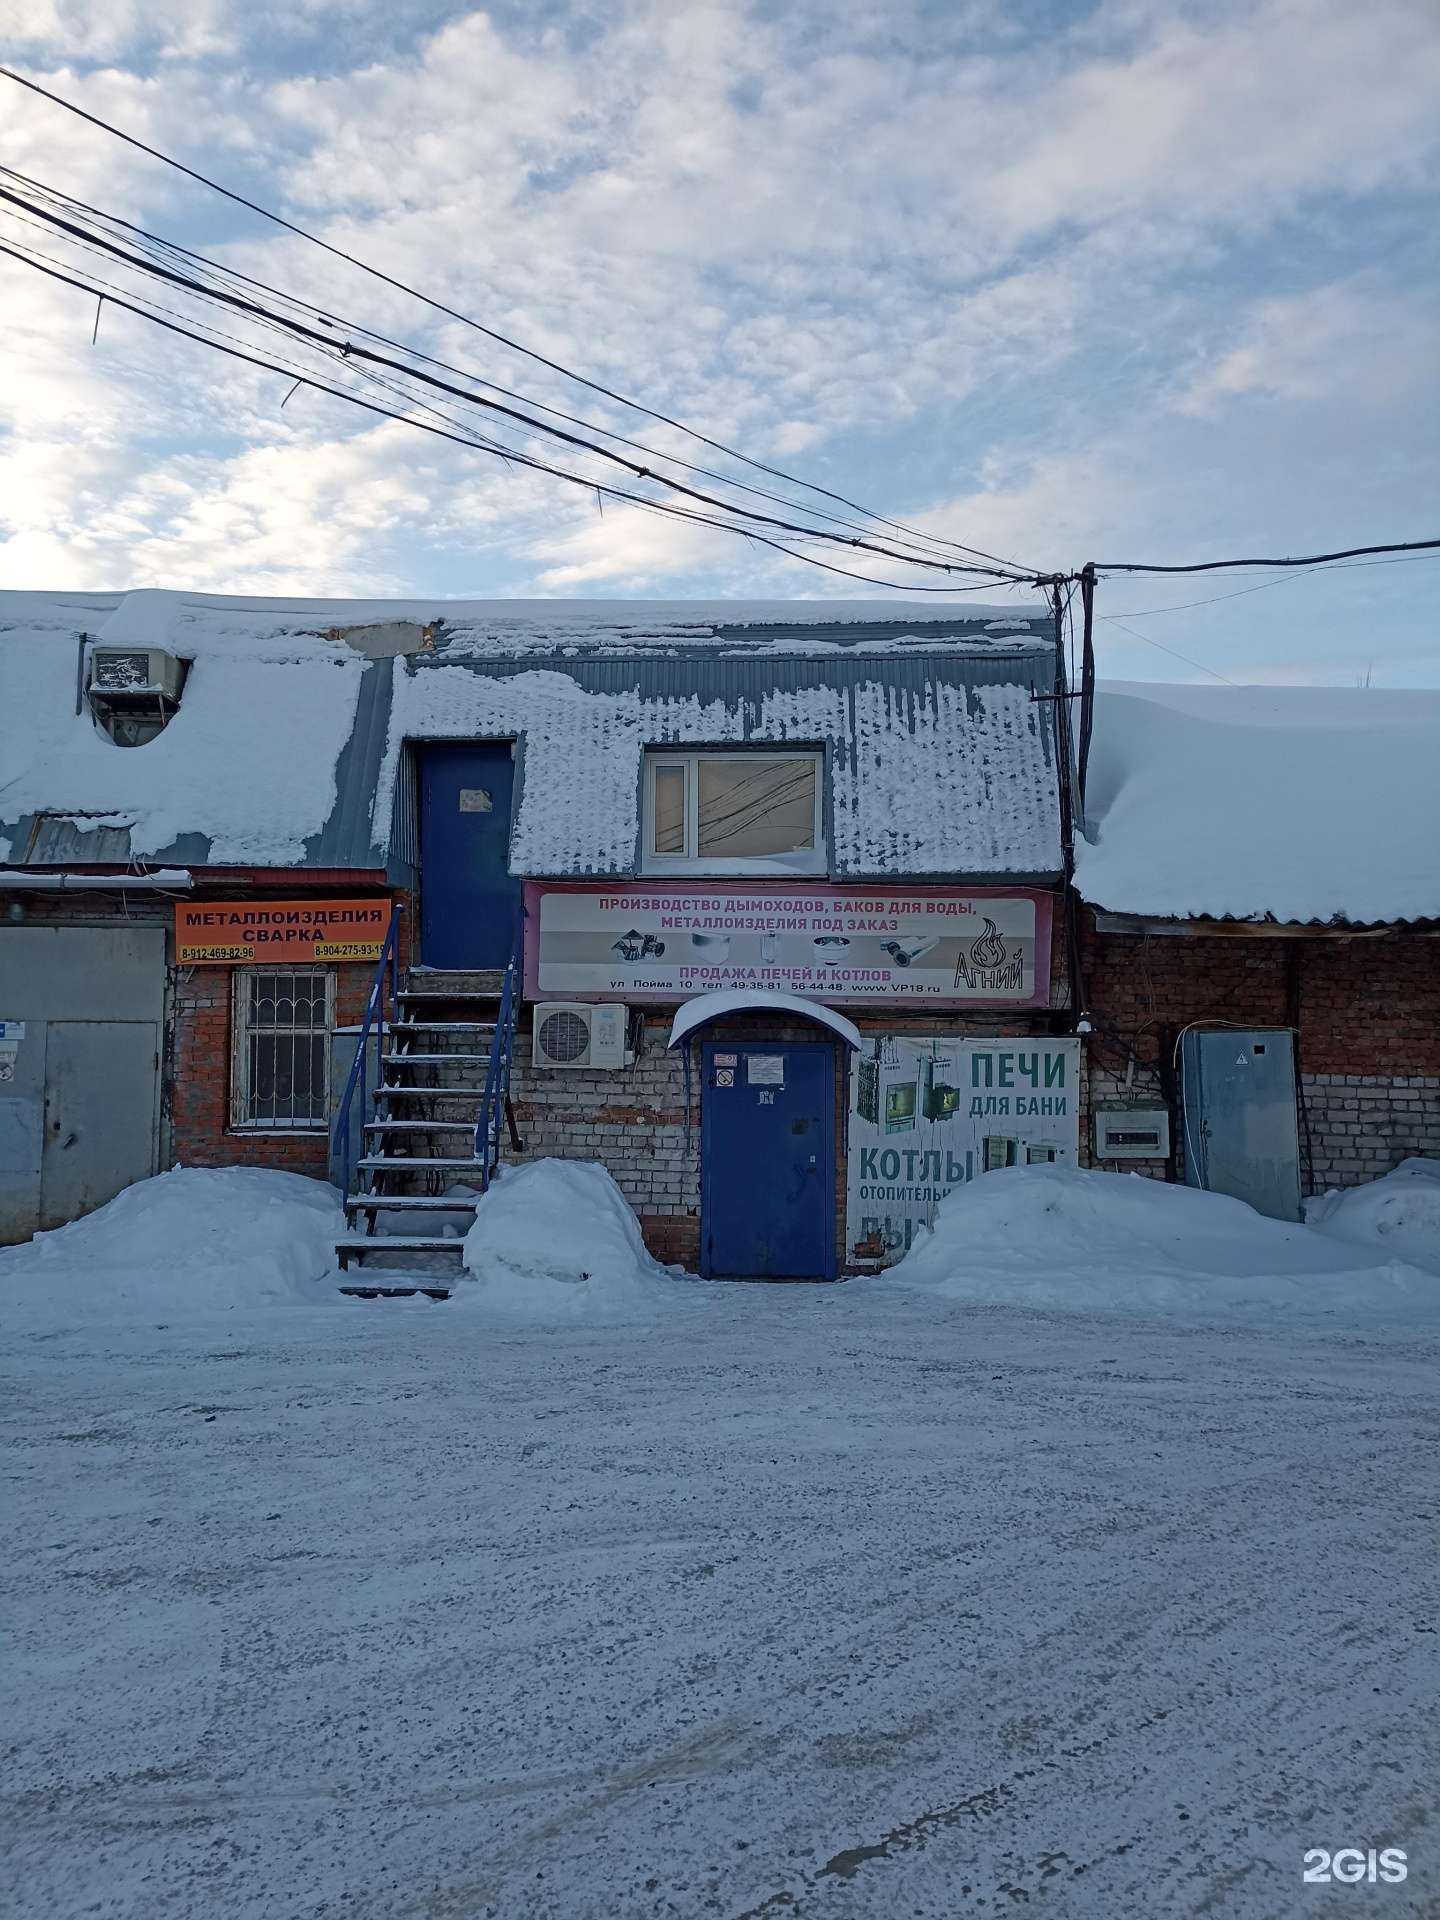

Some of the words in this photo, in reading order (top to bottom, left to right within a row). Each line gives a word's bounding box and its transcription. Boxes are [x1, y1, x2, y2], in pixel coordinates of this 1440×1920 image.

[599, 898, 721, 912] ПРОИЗВОДСТВО
[725, 899, 829, 914] ДЫМОХОДОВ,
[833, 901, 885, 914] БАКОВ
[888, 902, 922, 915] ДЛЯ
[926, 902, 977, 916] ВОДЫ,
[186, 909, 383, 926] МЕТАЛЛОИЗДЕЛИЯ
[661, 916, 807, 930] МЕТАЛЛОИЗДЕЛИЯ
[812, 918, 844, 931] ПОД
[847, 919, 898, 931] ЗАКАЗ
[242, 928, 325, 942] СВАРКА
[182, 947, 254, 959] 8-912-469-82-96
[679, 967, 757, 981] ПРОДАЖА
[761, 966, 812, 980] ПЕЧЕЙ
[817, 969, 827, 981] И
[832, 970, 892, 982] КОТЛОВ
[954, 947, 1024, 990] Агний
[633, 979, 673, 989] Пойма
[971, 1052, 1066, 1089] ПЕЧИ
[969, 1096, 1010, 1118] ДЛЯ
[1016, 1096, 1067, 1116] БАНИ
[860, 1146, 974, 1183] КОТЛЫ
